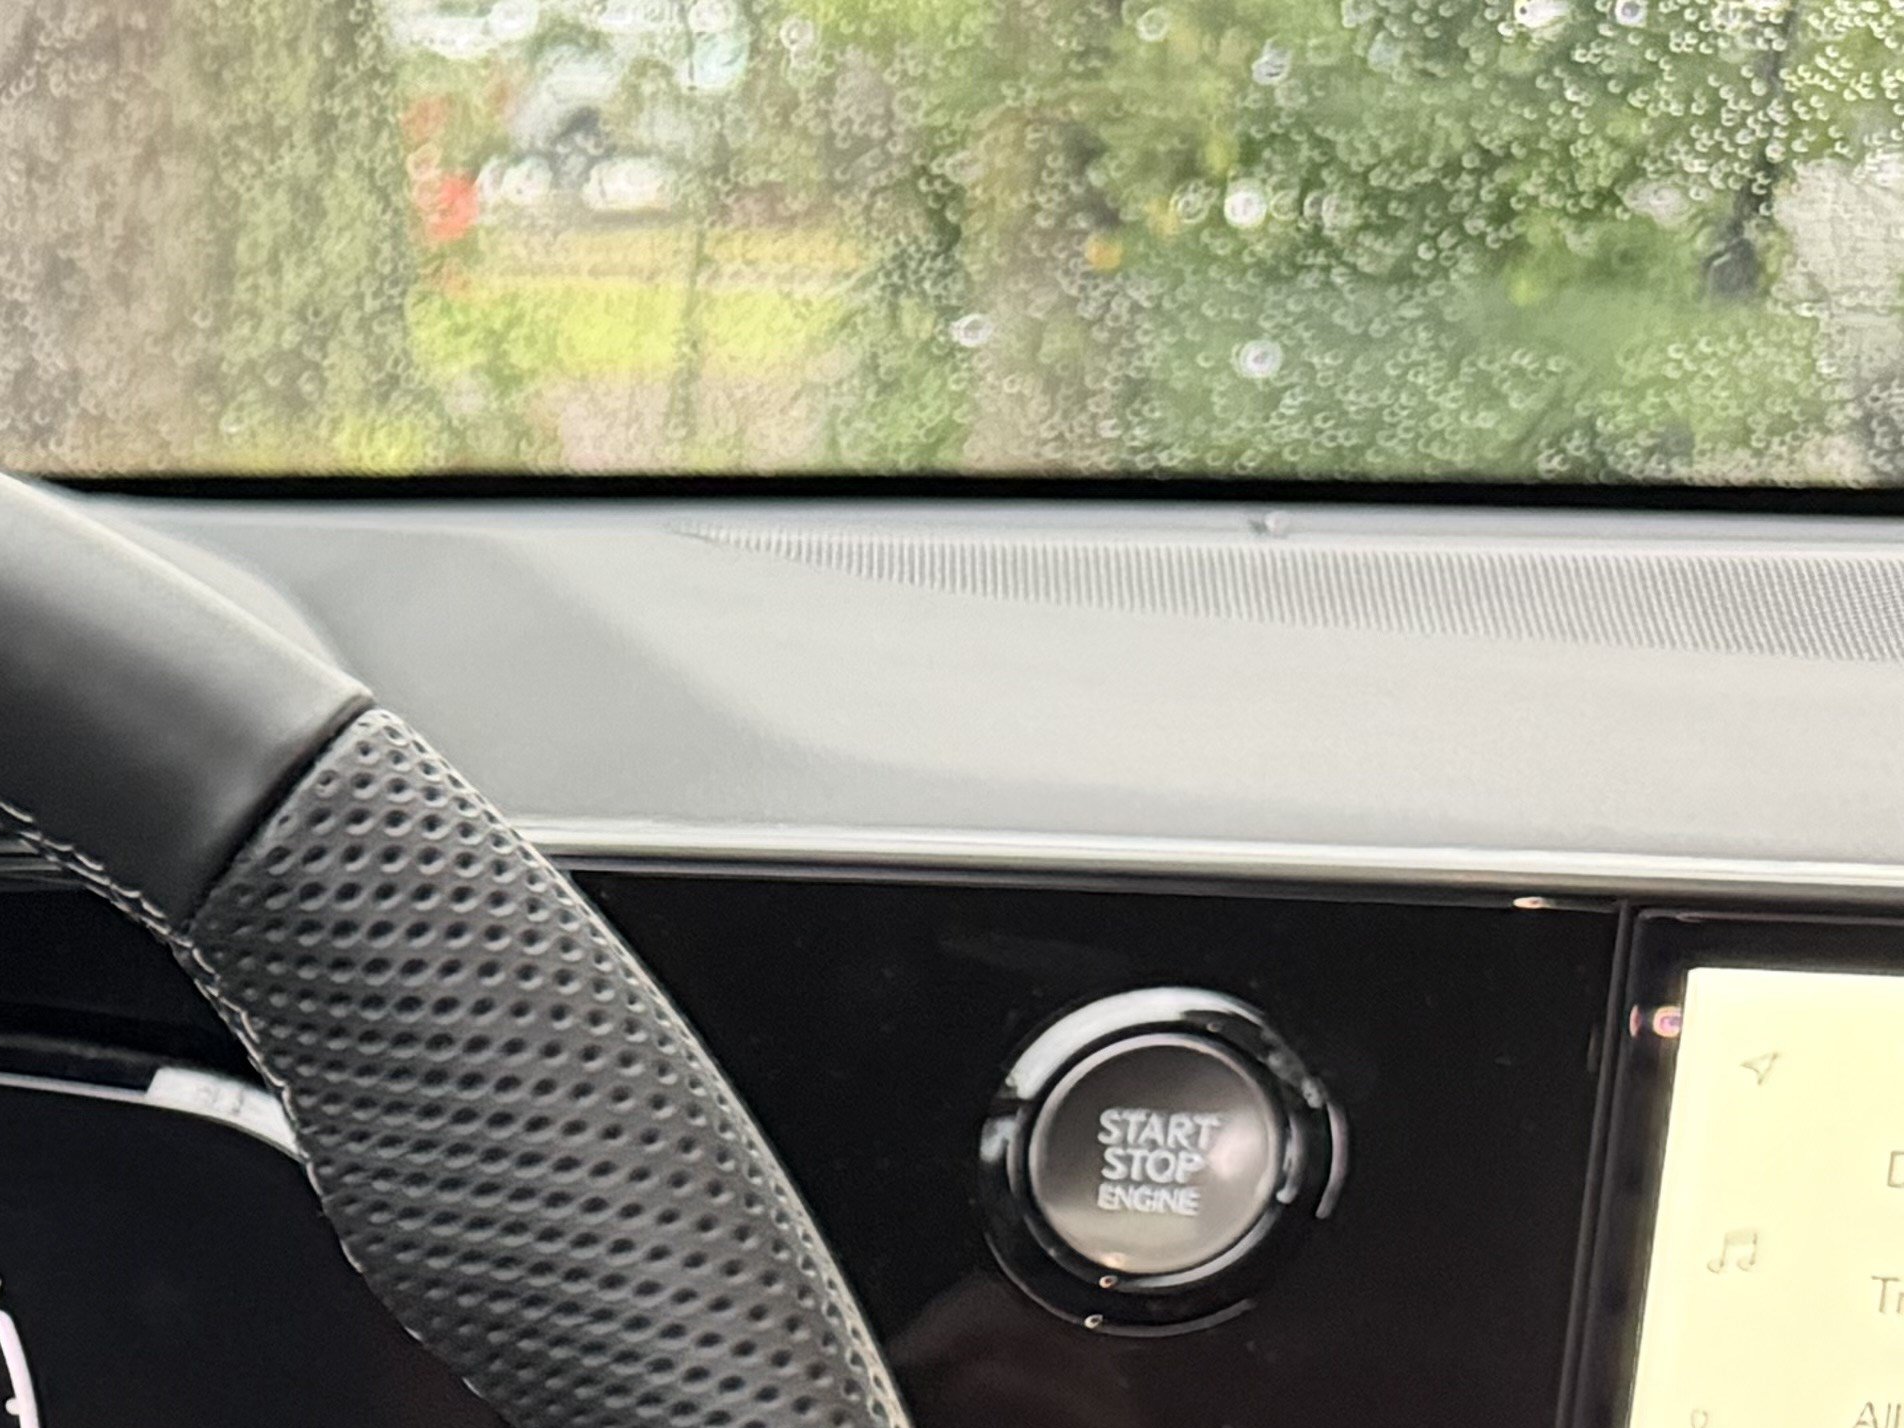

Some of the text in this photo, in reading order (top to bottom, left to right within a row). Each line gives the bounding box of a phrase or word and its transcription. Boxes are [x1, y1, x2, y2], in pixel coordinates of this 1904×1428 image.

[1098, 1108, 1222, 1149] START
[1102, 1147, 1206, 1184] STOP
[1097, 1182, 1200, 1216] ENGINE
